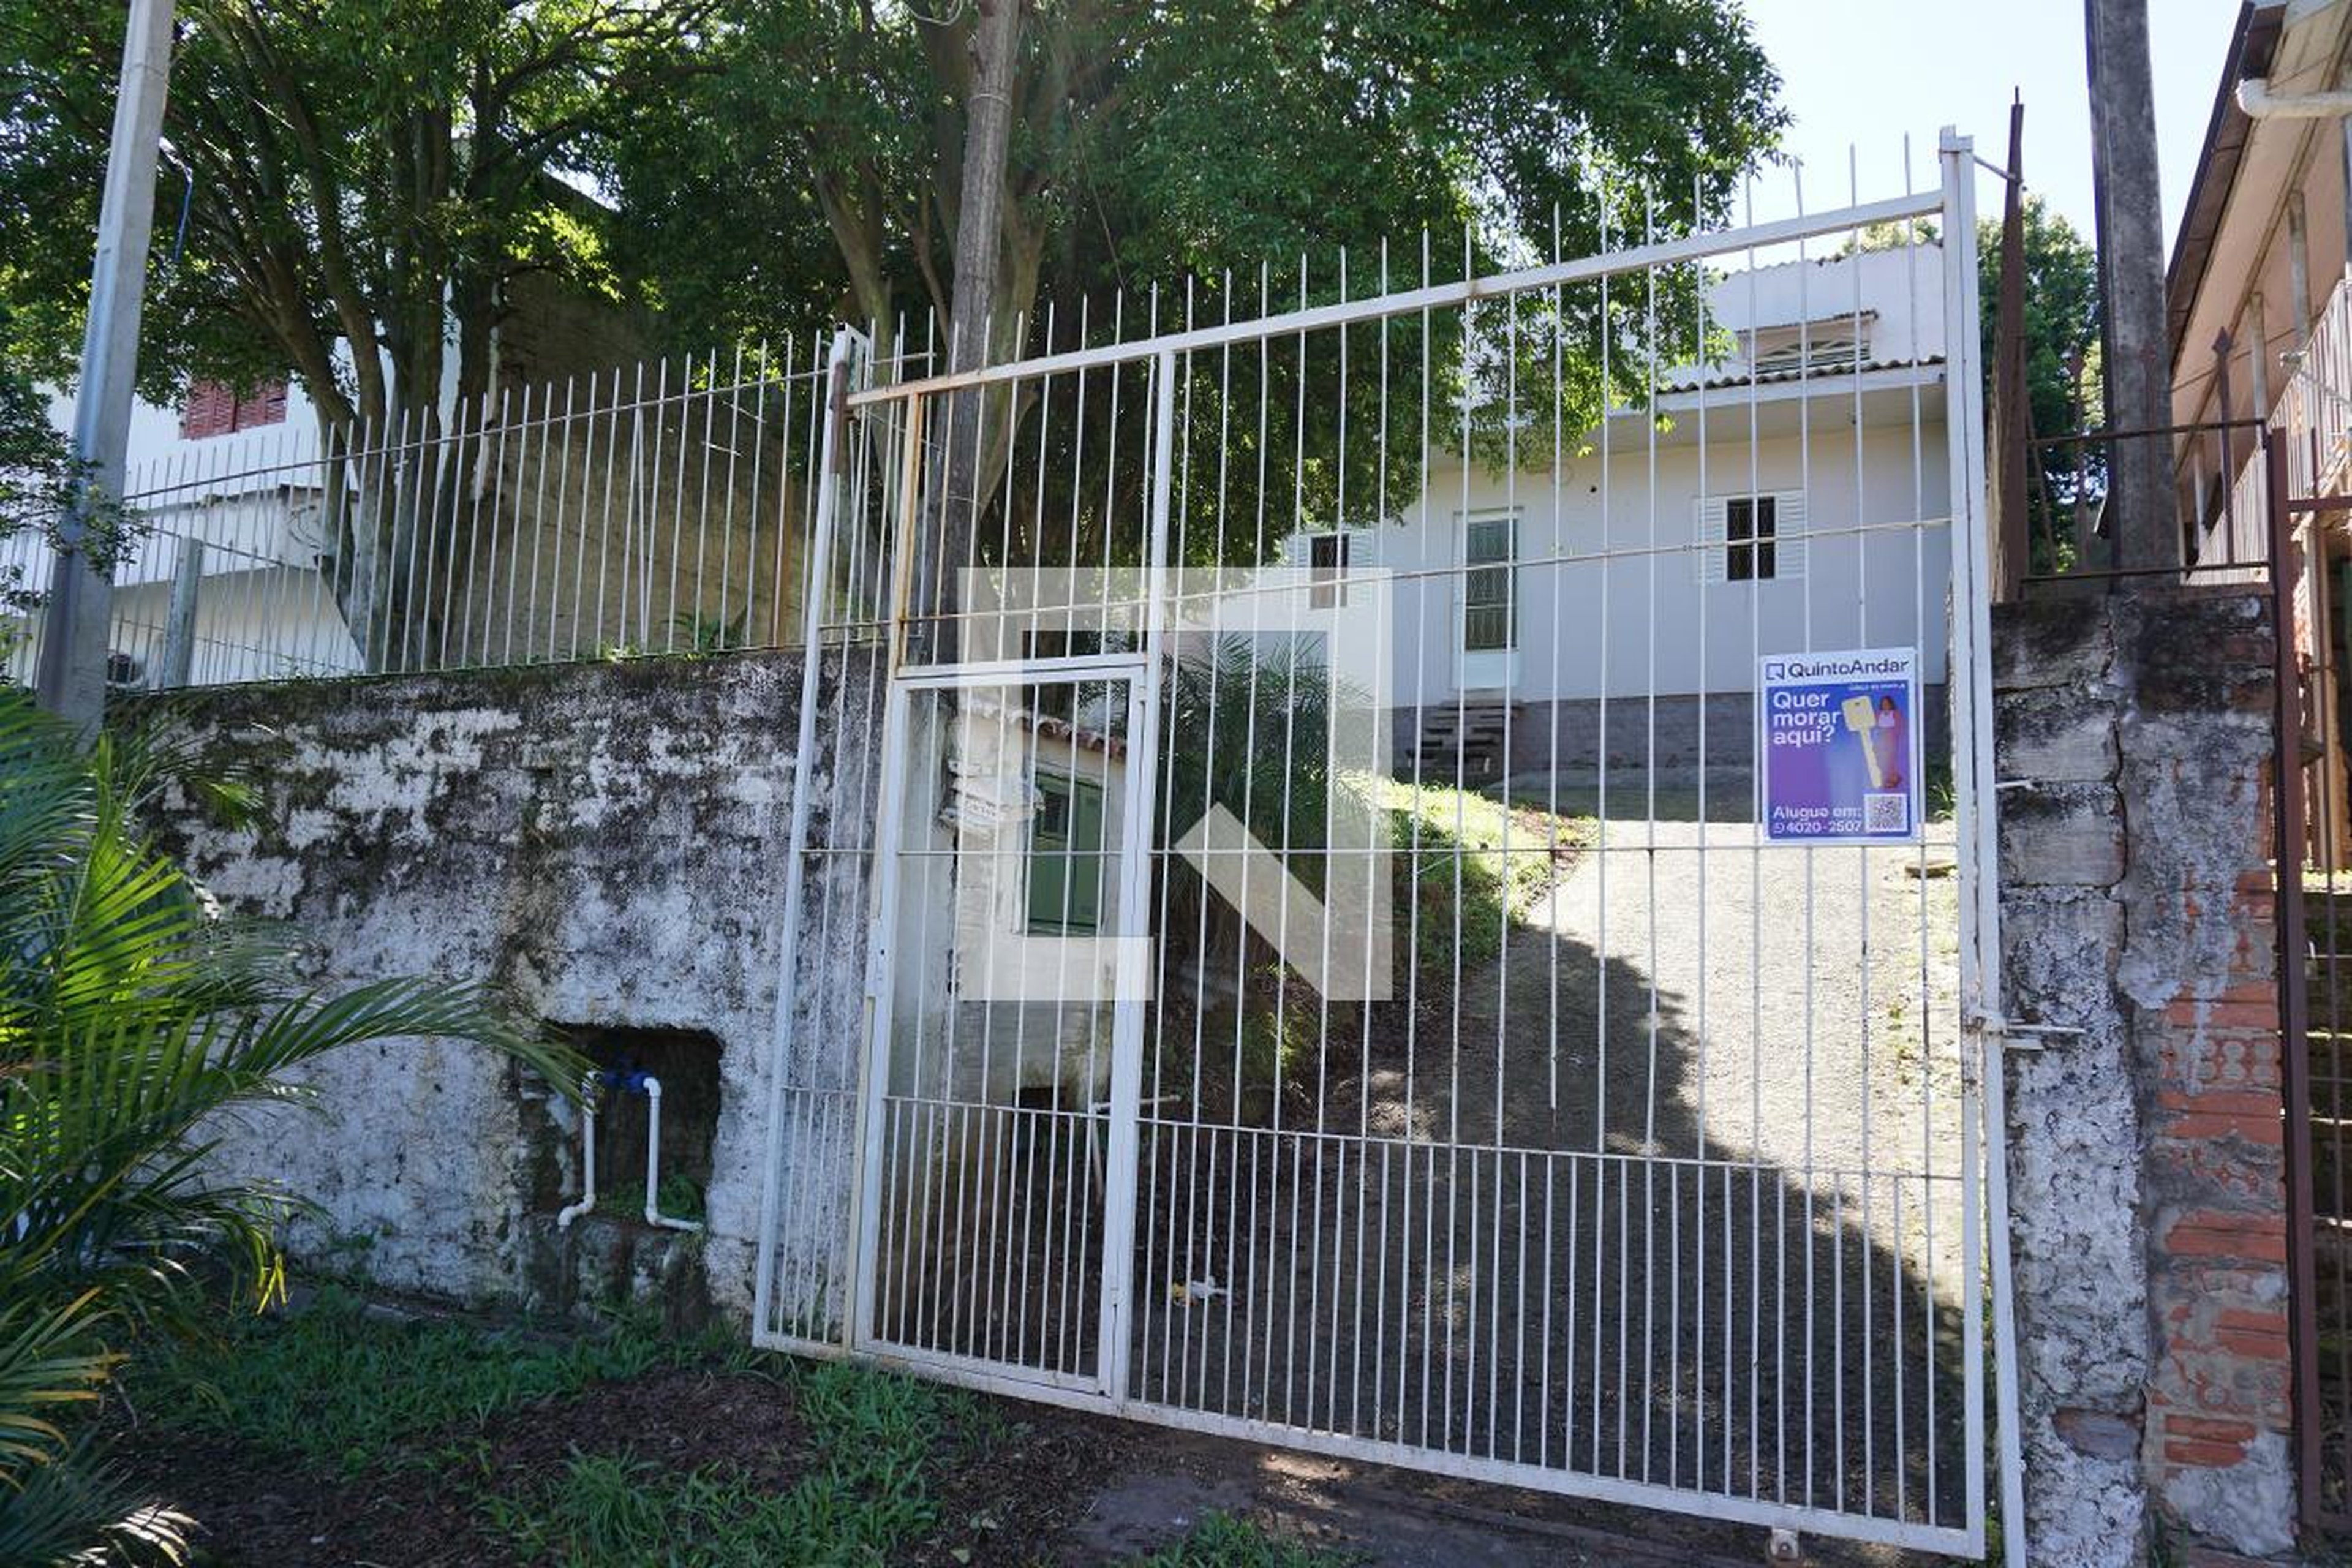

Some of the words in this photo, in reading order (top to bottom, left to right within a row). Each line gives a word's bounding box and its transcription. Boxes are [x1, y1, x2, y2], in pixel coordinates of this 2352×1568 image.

[1789, 659, 1909, 678] QuintoAndar
[1773, 692, 1830, 709] Quer
[1773, 711, 1840, 726] morar
[1773, 726, 1836, 747] aqui?
[1773, 805, 1829, 822] Alugue
